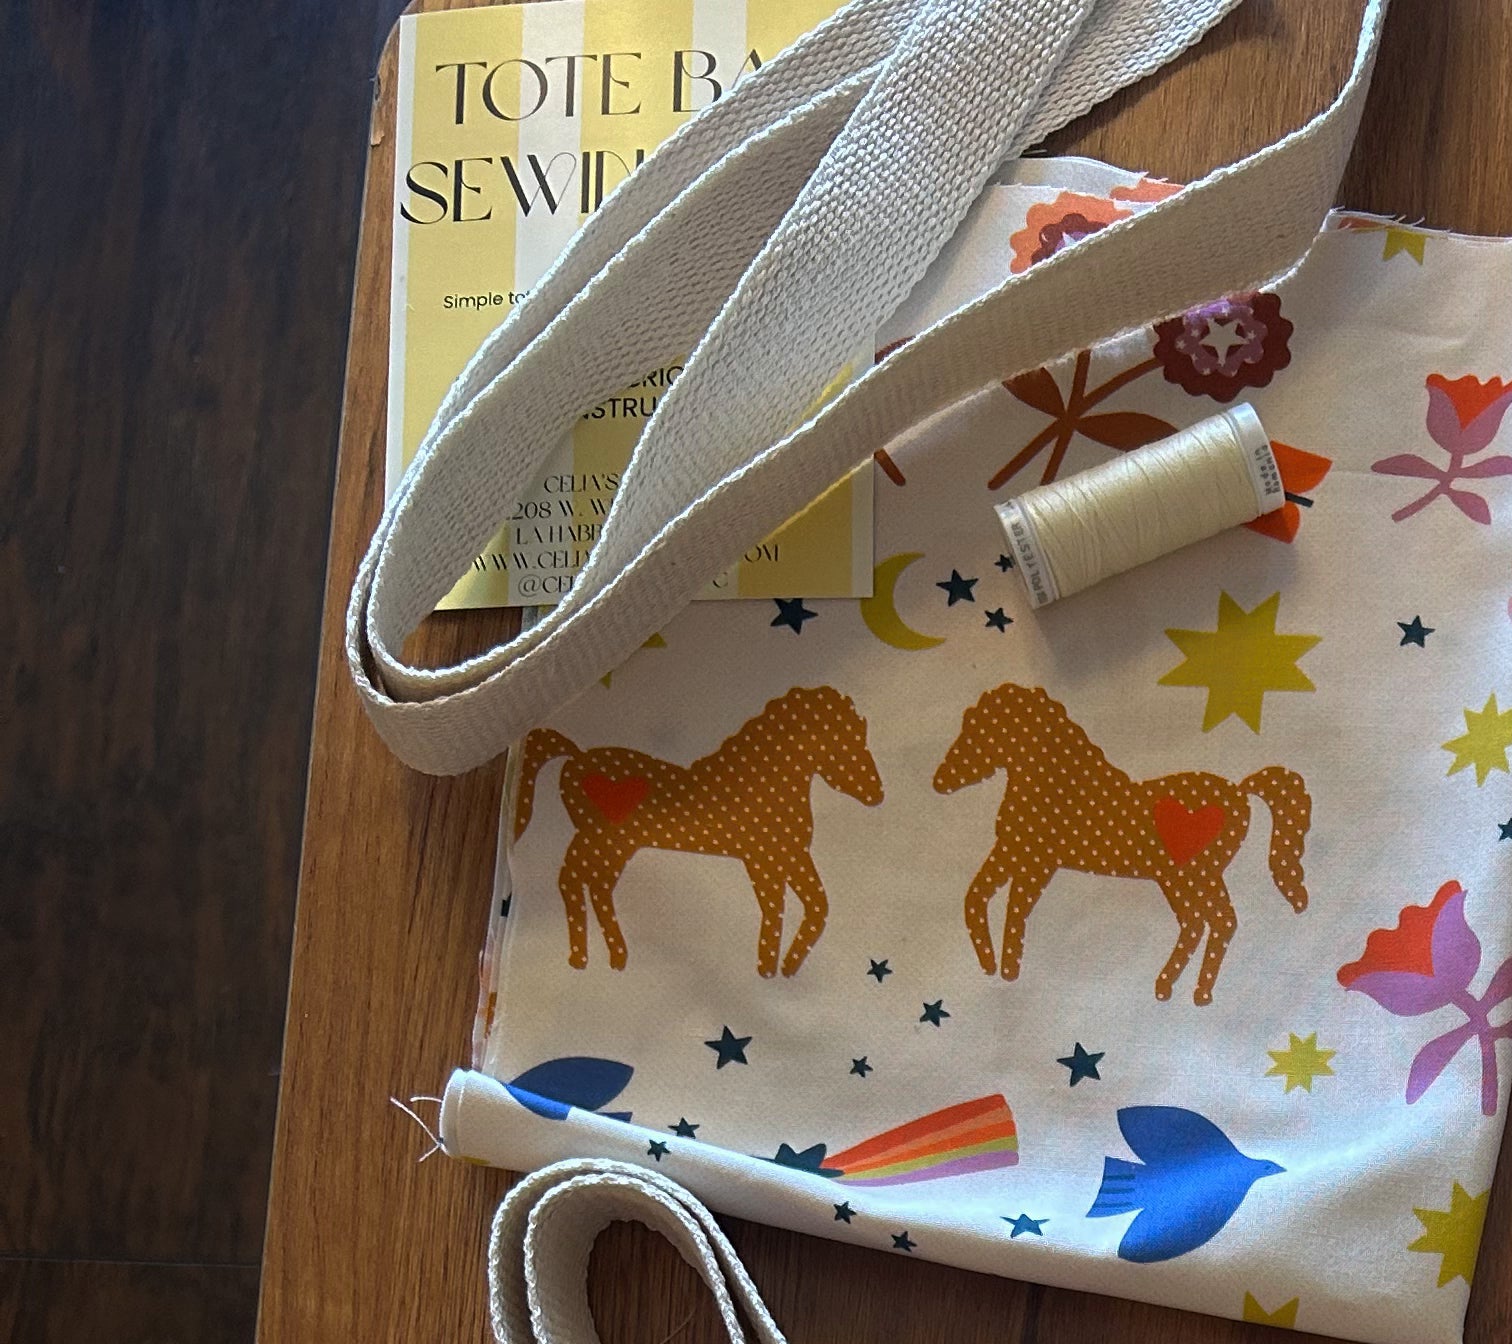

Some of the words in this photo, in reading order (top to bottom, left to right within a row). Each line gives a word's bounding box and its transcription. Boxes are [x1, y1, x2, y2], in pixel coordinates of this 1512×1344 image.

[435, 52, 642, 126] TOTE
[400, 149, 645, 226] SEWIN
[443, 290, 504, 310] Simple
[543, 473, 620, 494] CELIA'S
[506, 501, 551, 521] 208
